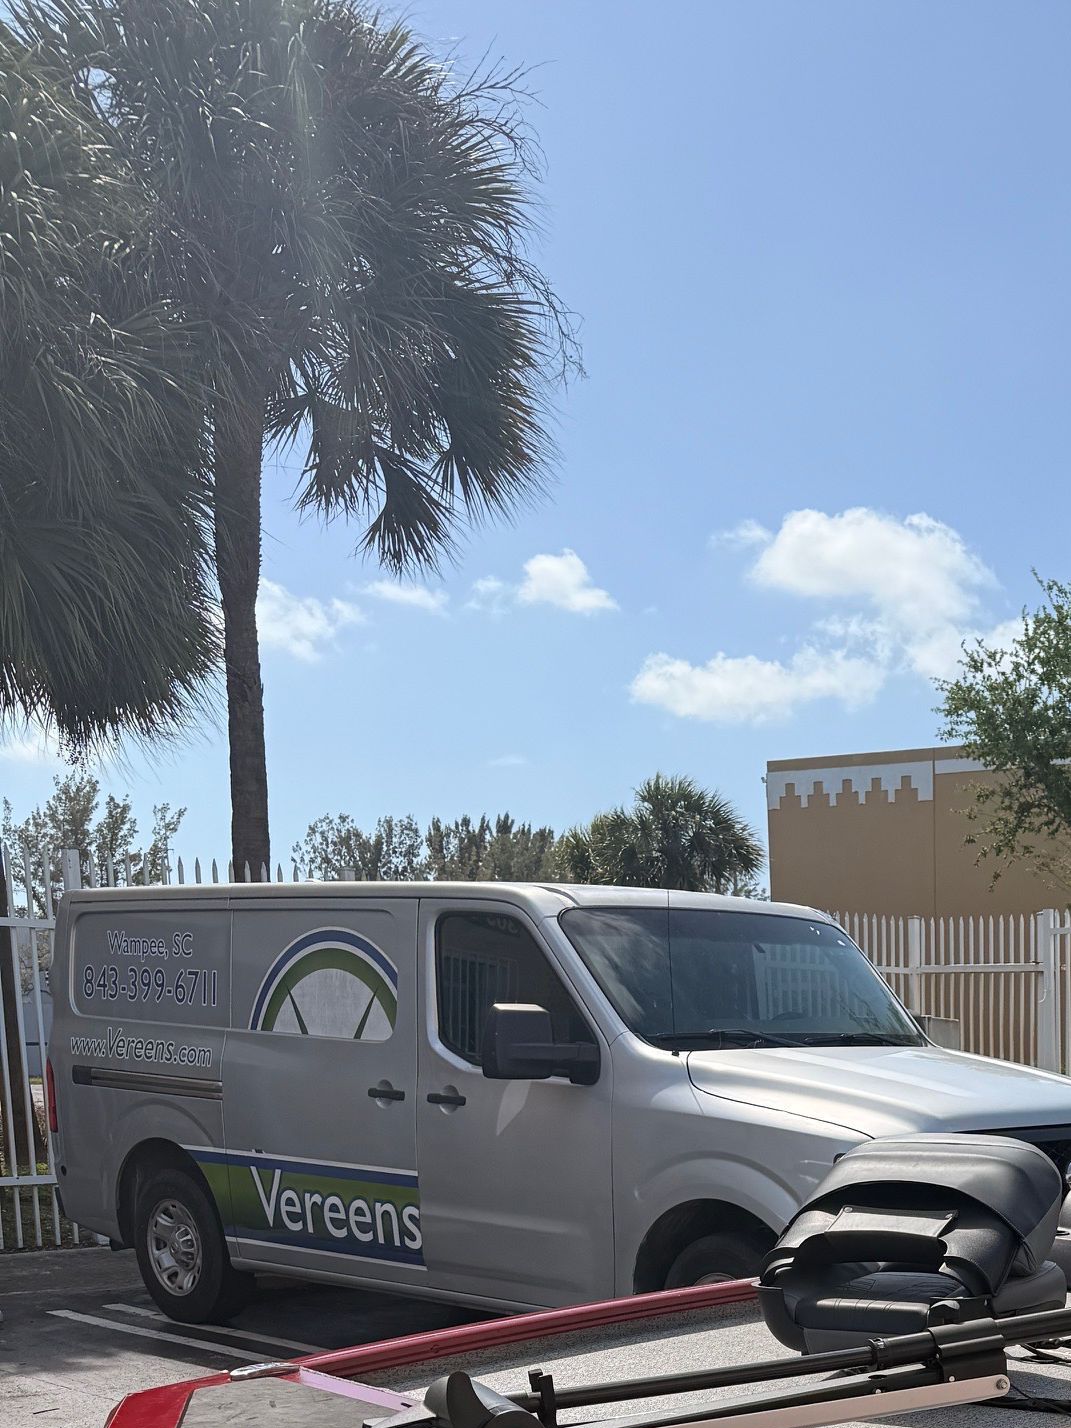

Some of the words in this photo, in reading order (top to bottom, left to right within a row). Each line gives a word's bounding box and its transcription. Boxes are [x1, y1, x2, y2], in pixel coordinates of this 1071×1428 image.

[107, 930, 169, 962] Wampee,
[172, 931, 194, 958] SC
[83, 964, 218, 1007] 843-399-6711
[70, 1027, 212, 1067] www.Vereens.com
[250, 1165, 423, 1250] Vereens
